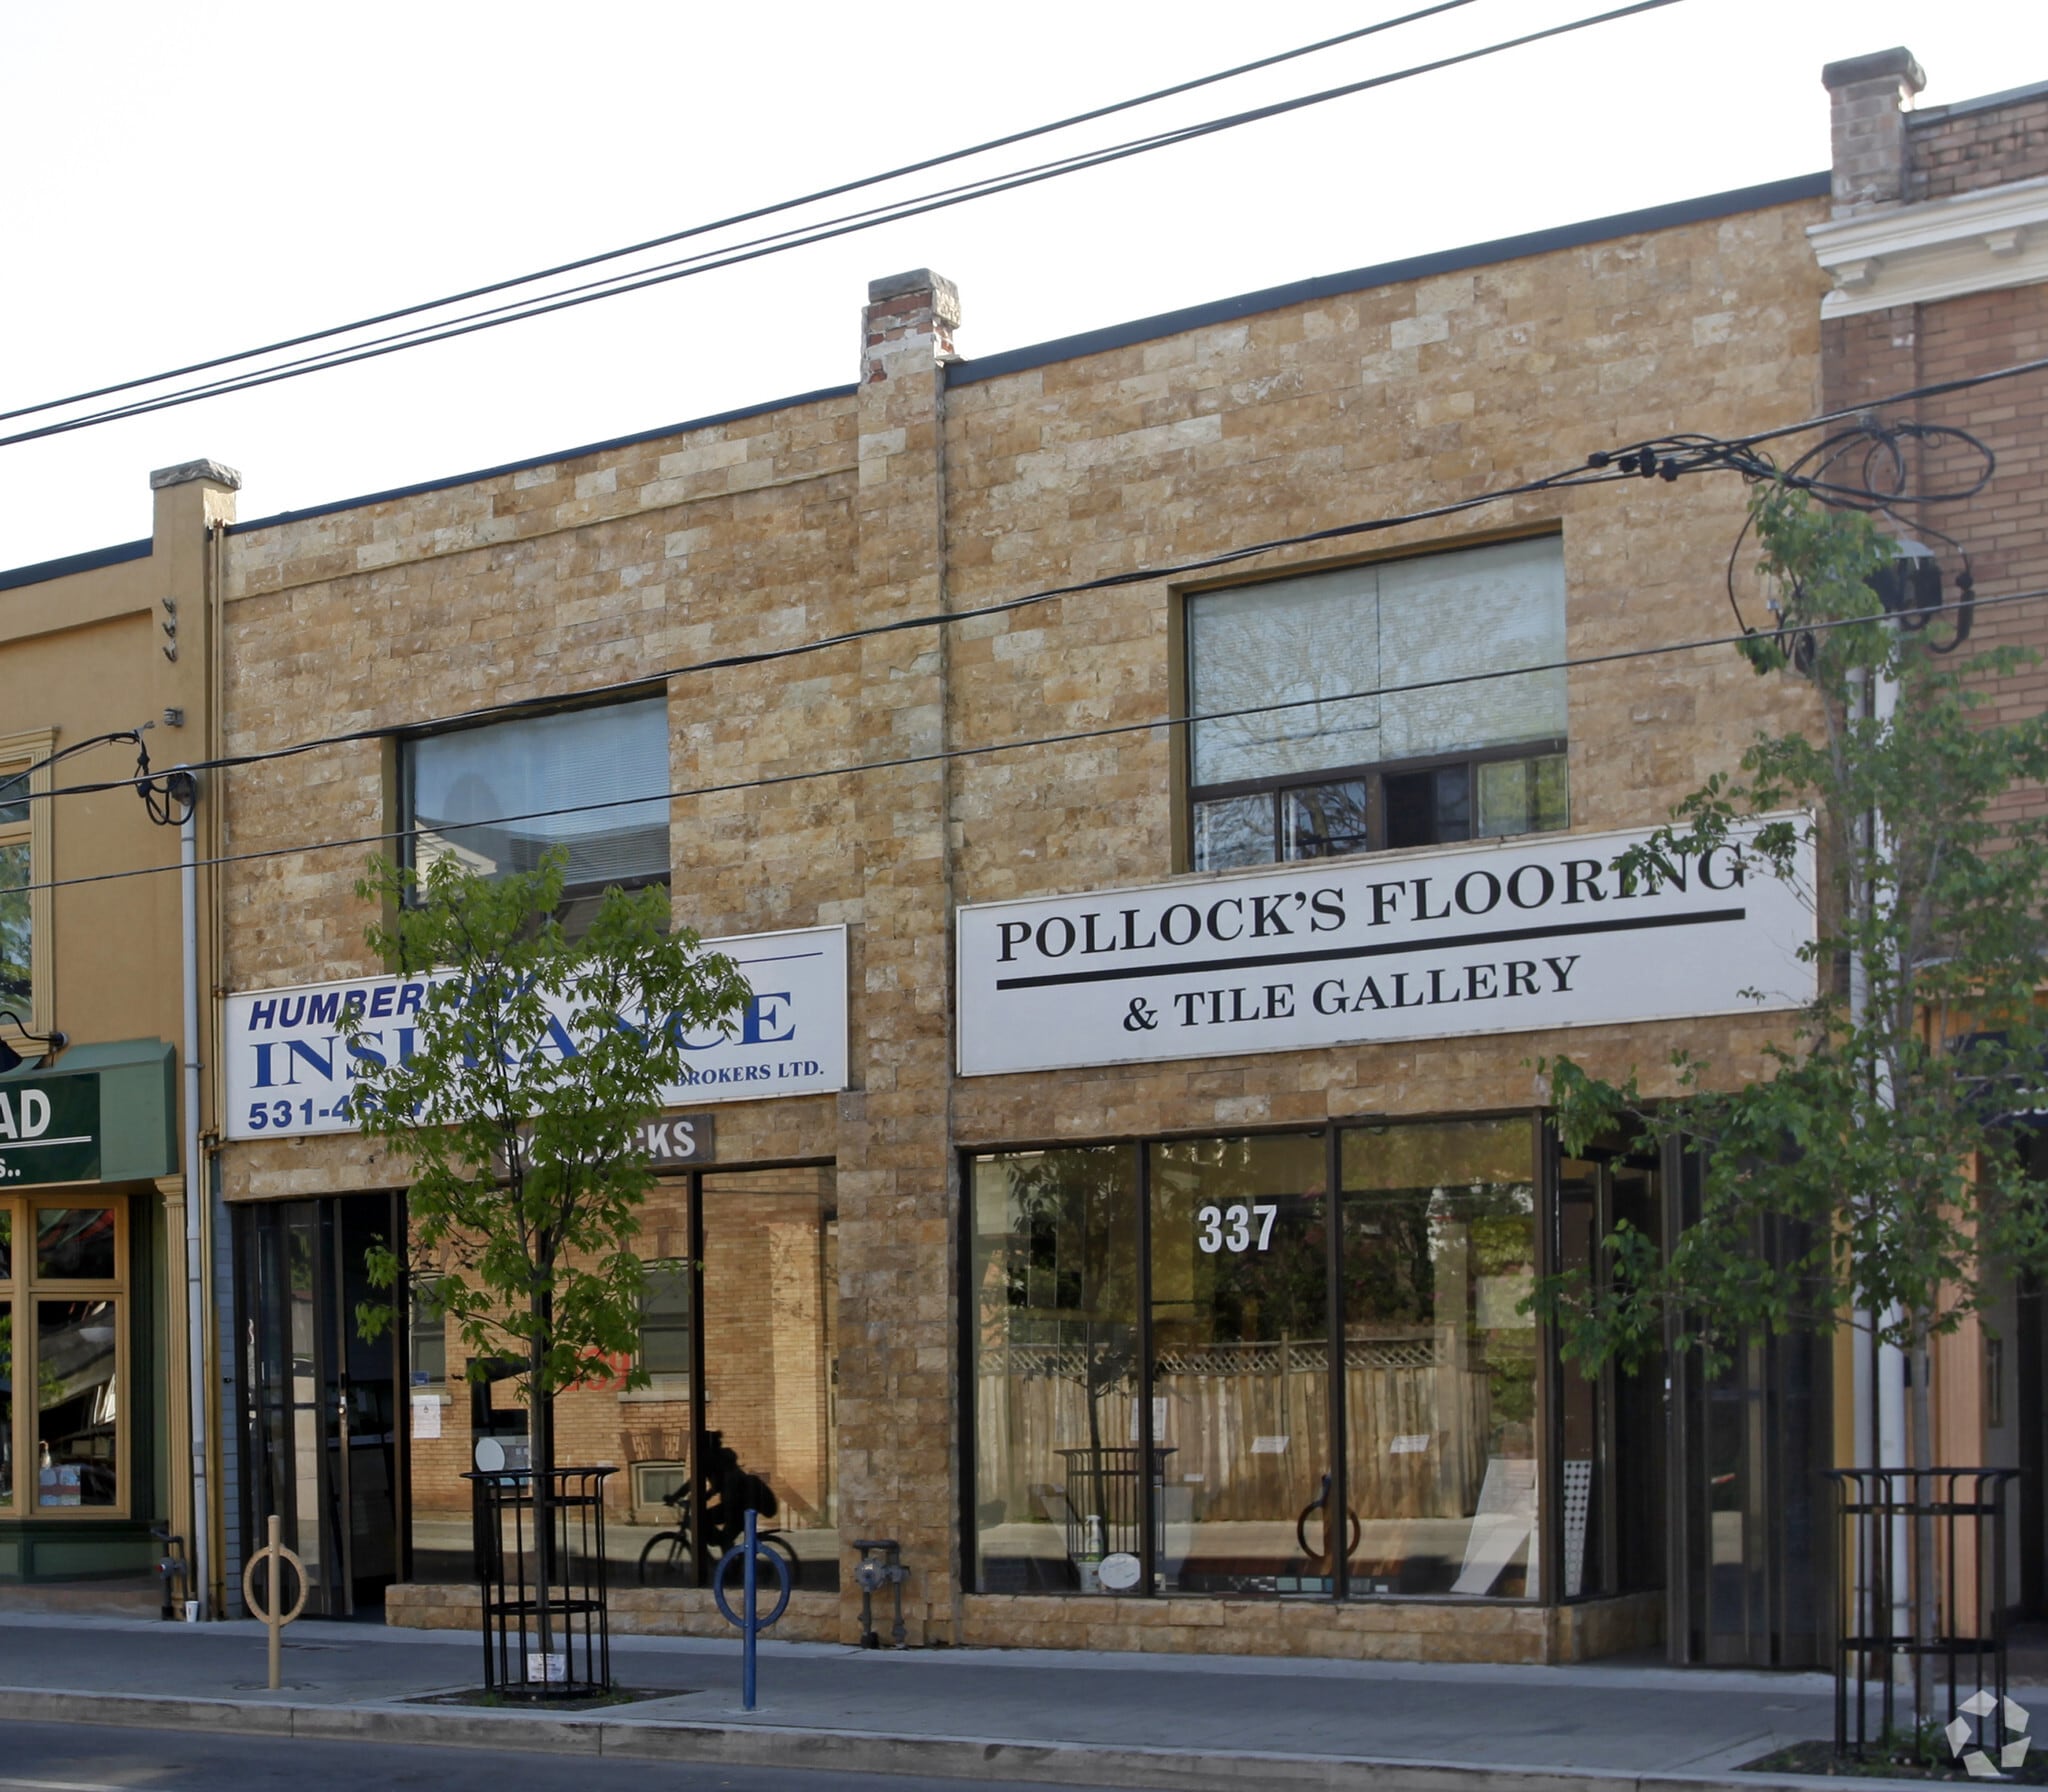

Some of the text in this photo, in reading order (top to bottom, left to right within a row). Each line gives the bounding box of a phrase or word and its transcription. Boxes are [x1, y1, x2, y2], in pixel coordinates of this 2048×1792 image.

[996, 843, 1745, 962] POLLOCK'S FLOORING
[1123, 955, 1581, 1031] & TILE GALLERY
[675, 1060, 824, 1087] BROKERS LTD.
[1198, 1204, 1277, 1253] 337
